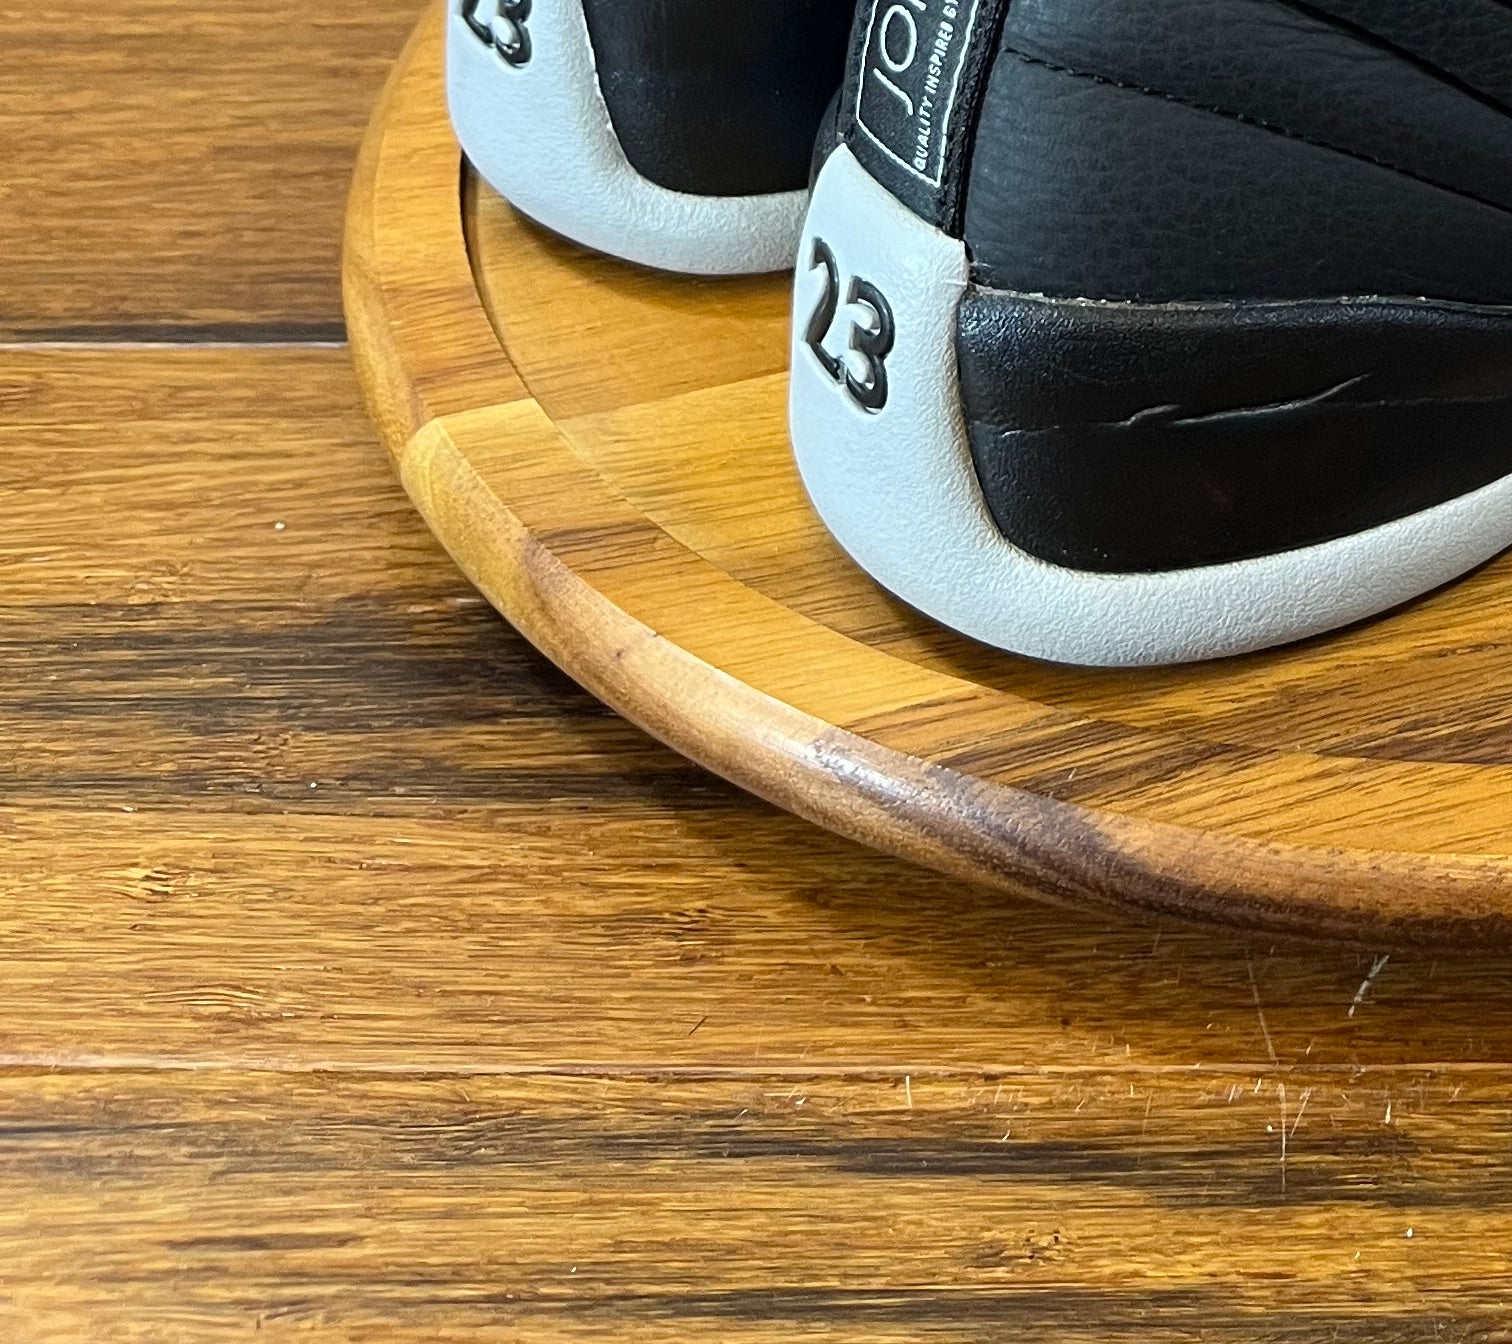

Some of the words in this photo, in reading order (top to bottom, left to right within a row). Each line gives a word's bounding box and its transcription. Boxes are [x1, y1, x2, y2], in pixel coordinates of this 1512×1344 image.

[912, 95, 933, 172] QUALITY
[923, 20, 955, 94] INSPIRED
[802, 235, 896, 416] 23
